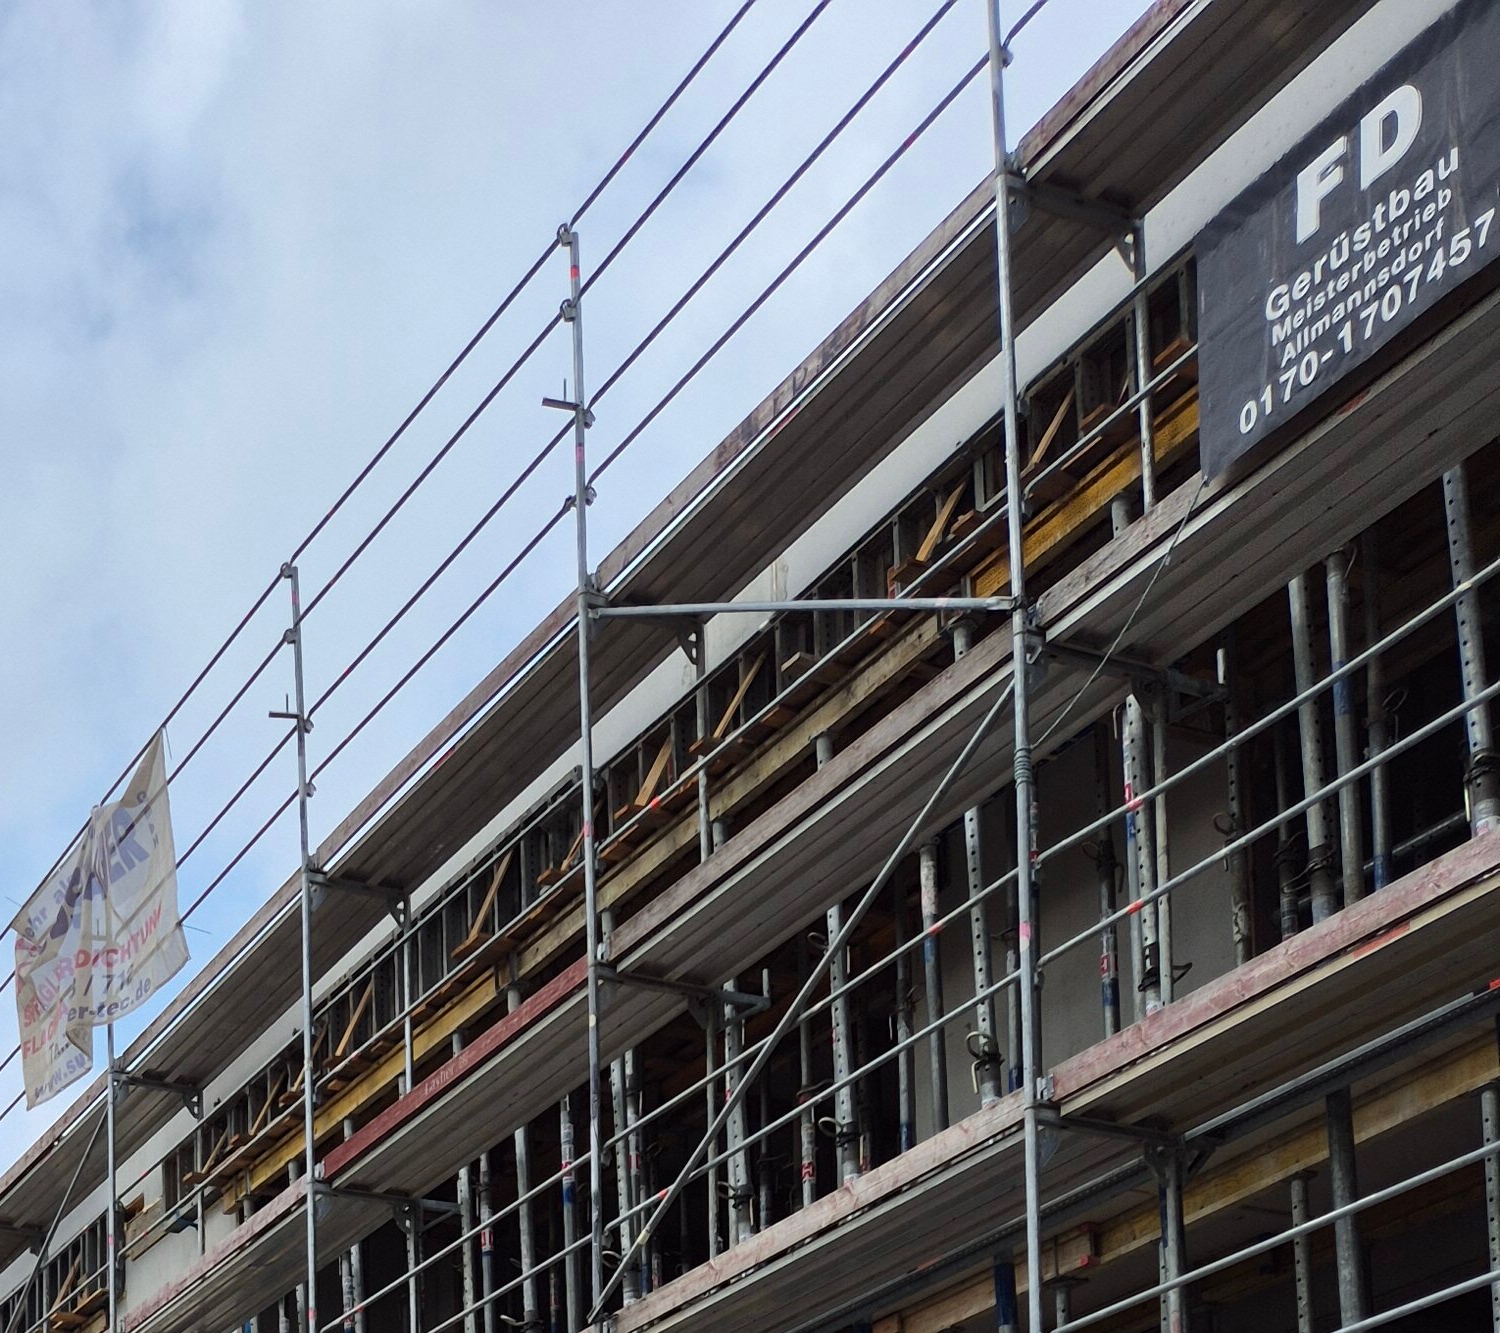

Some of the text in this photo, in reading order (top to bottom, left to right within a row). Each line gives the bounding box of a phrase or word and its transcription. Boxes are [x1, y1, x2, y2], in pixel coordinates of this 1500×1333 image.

[1265, 147, 1459, 322] Gerüstbau
[1295, 84, 1423, 245] FD
[1239, 207, 1496, 435] 0170-1707457
[1272, 187, 1452, 347] Meisterbetrieb
[1280, 219, 1445, 370] Allmannsdorf
[67, 976, 151, 1022] er-tec.de
